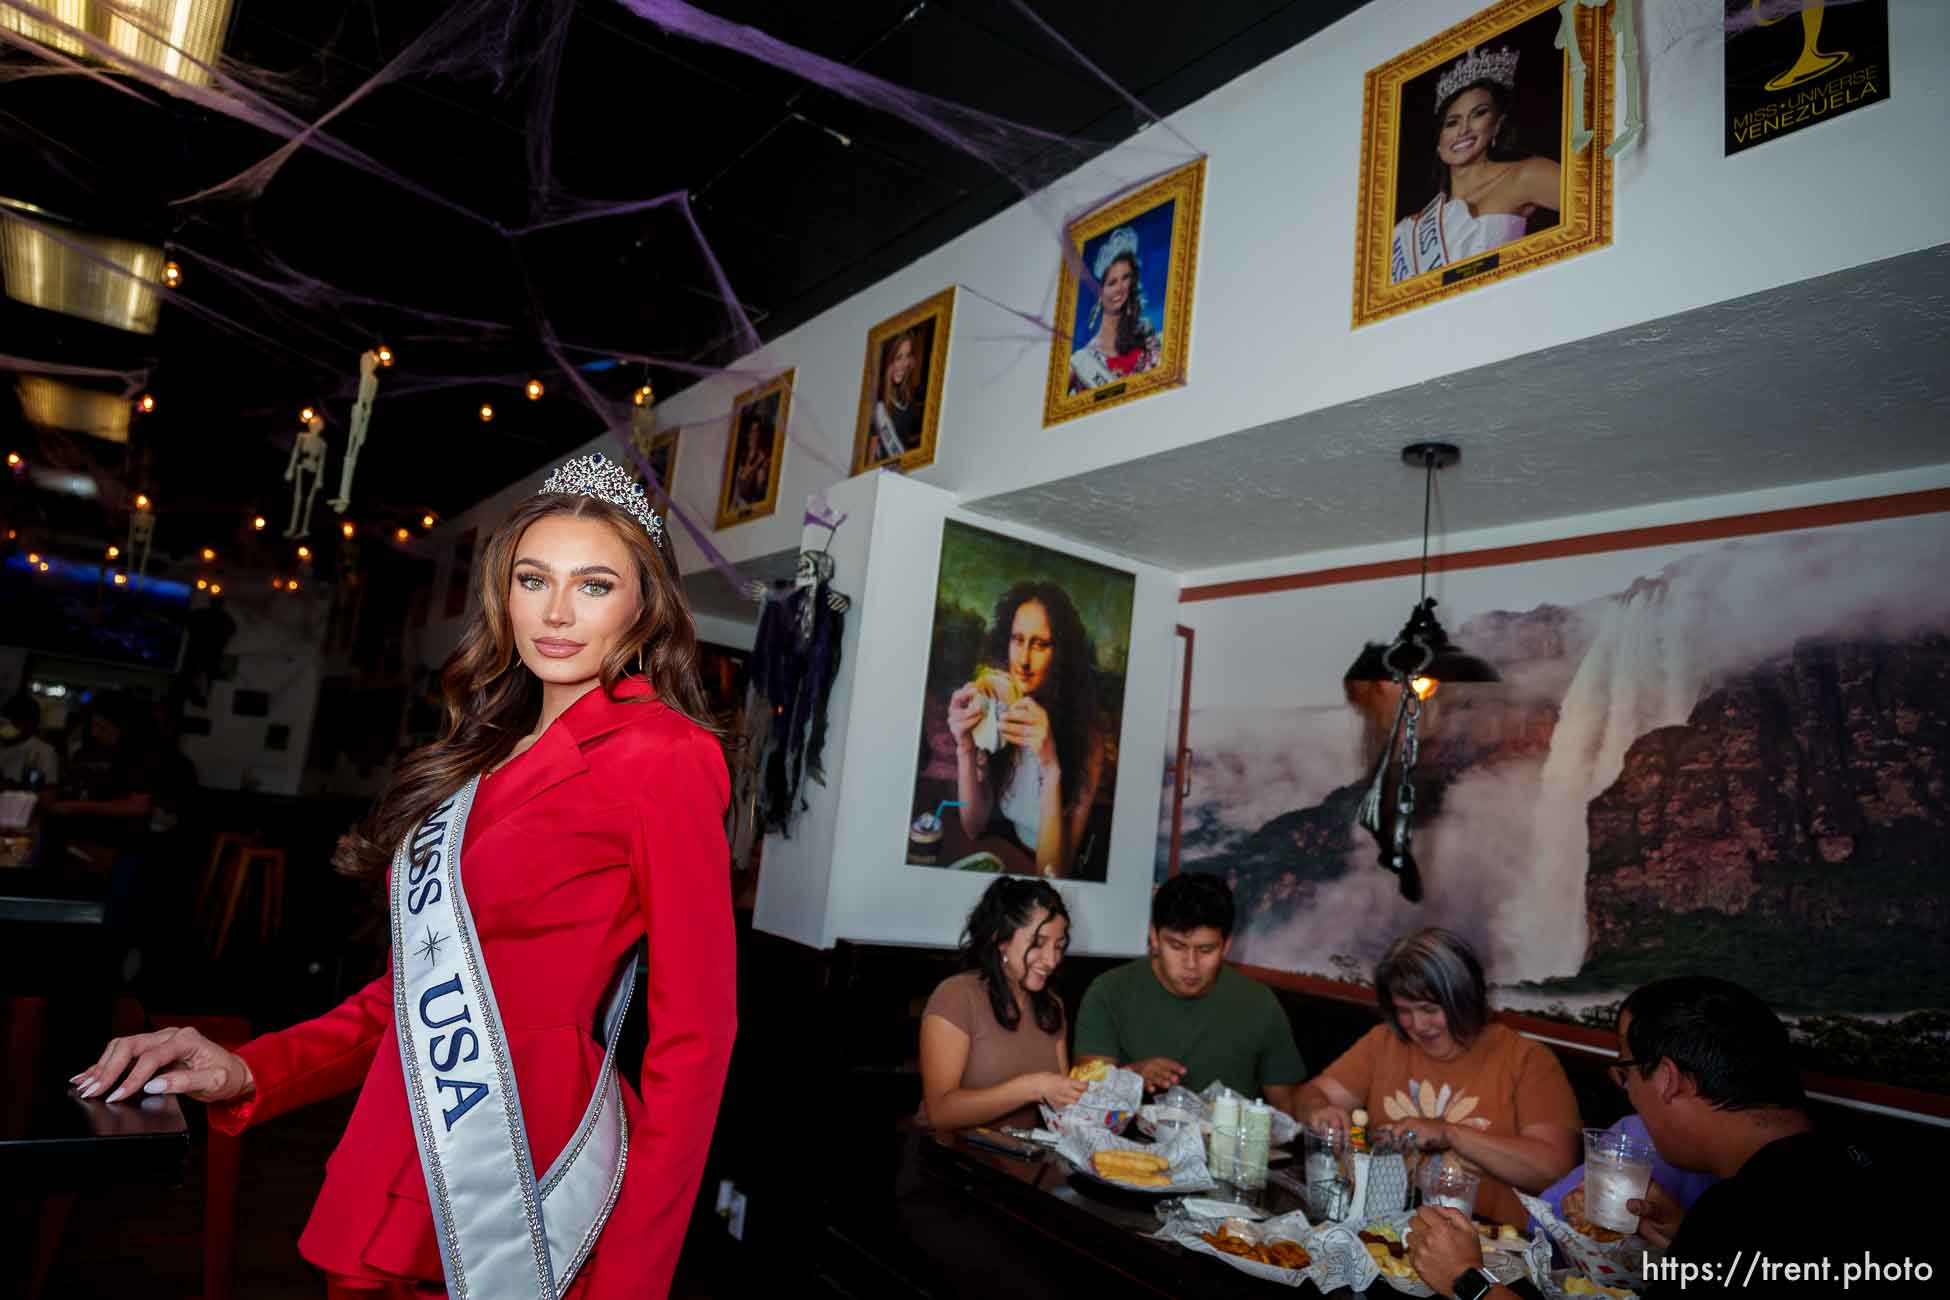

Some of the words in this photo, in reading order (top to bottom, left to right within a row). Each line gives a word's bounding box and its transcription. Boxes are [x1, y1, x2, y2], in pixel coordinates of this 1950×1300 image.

[1733, 81, 1878, 144] VENEZUELA
[408, 800, 455, 915] MISS
[418, 972, 489, 1132] USA
